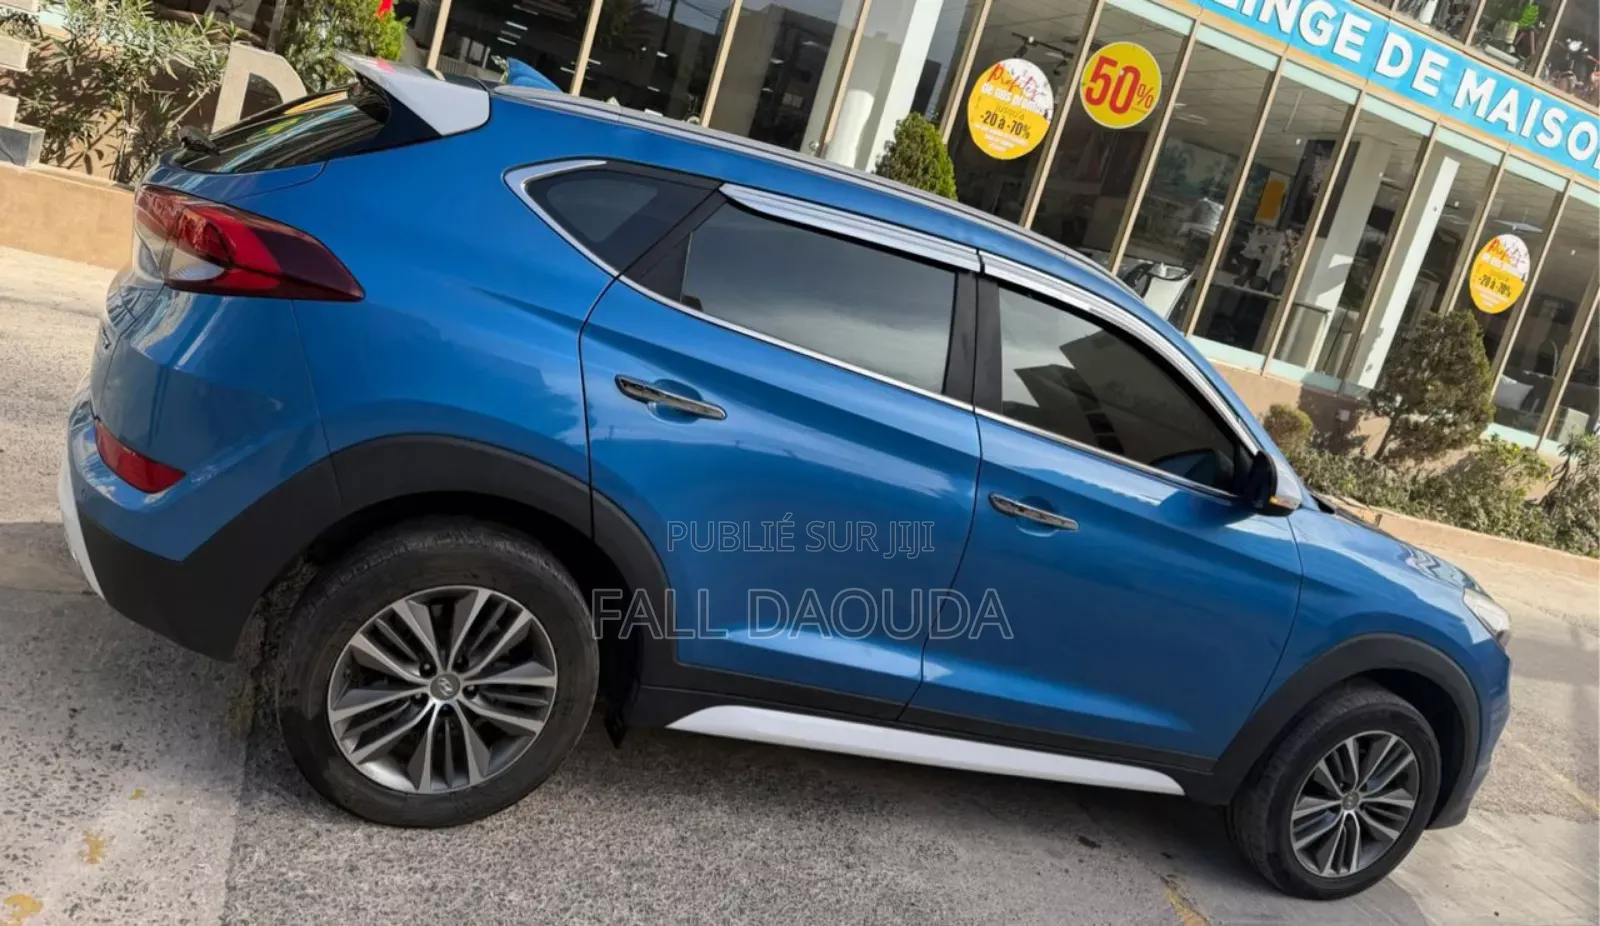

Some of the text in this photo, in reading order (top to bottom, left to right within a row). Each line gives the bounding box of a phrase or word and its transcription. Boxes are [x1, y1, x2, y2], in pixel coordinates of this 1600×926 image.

[1085, 55, 1155, 114] 50%
[1212, 0, 1600, 169] NGE DE MAISO
[980, 110, 998, 127] -20
[1007, 119, 1031, 140] -70%
